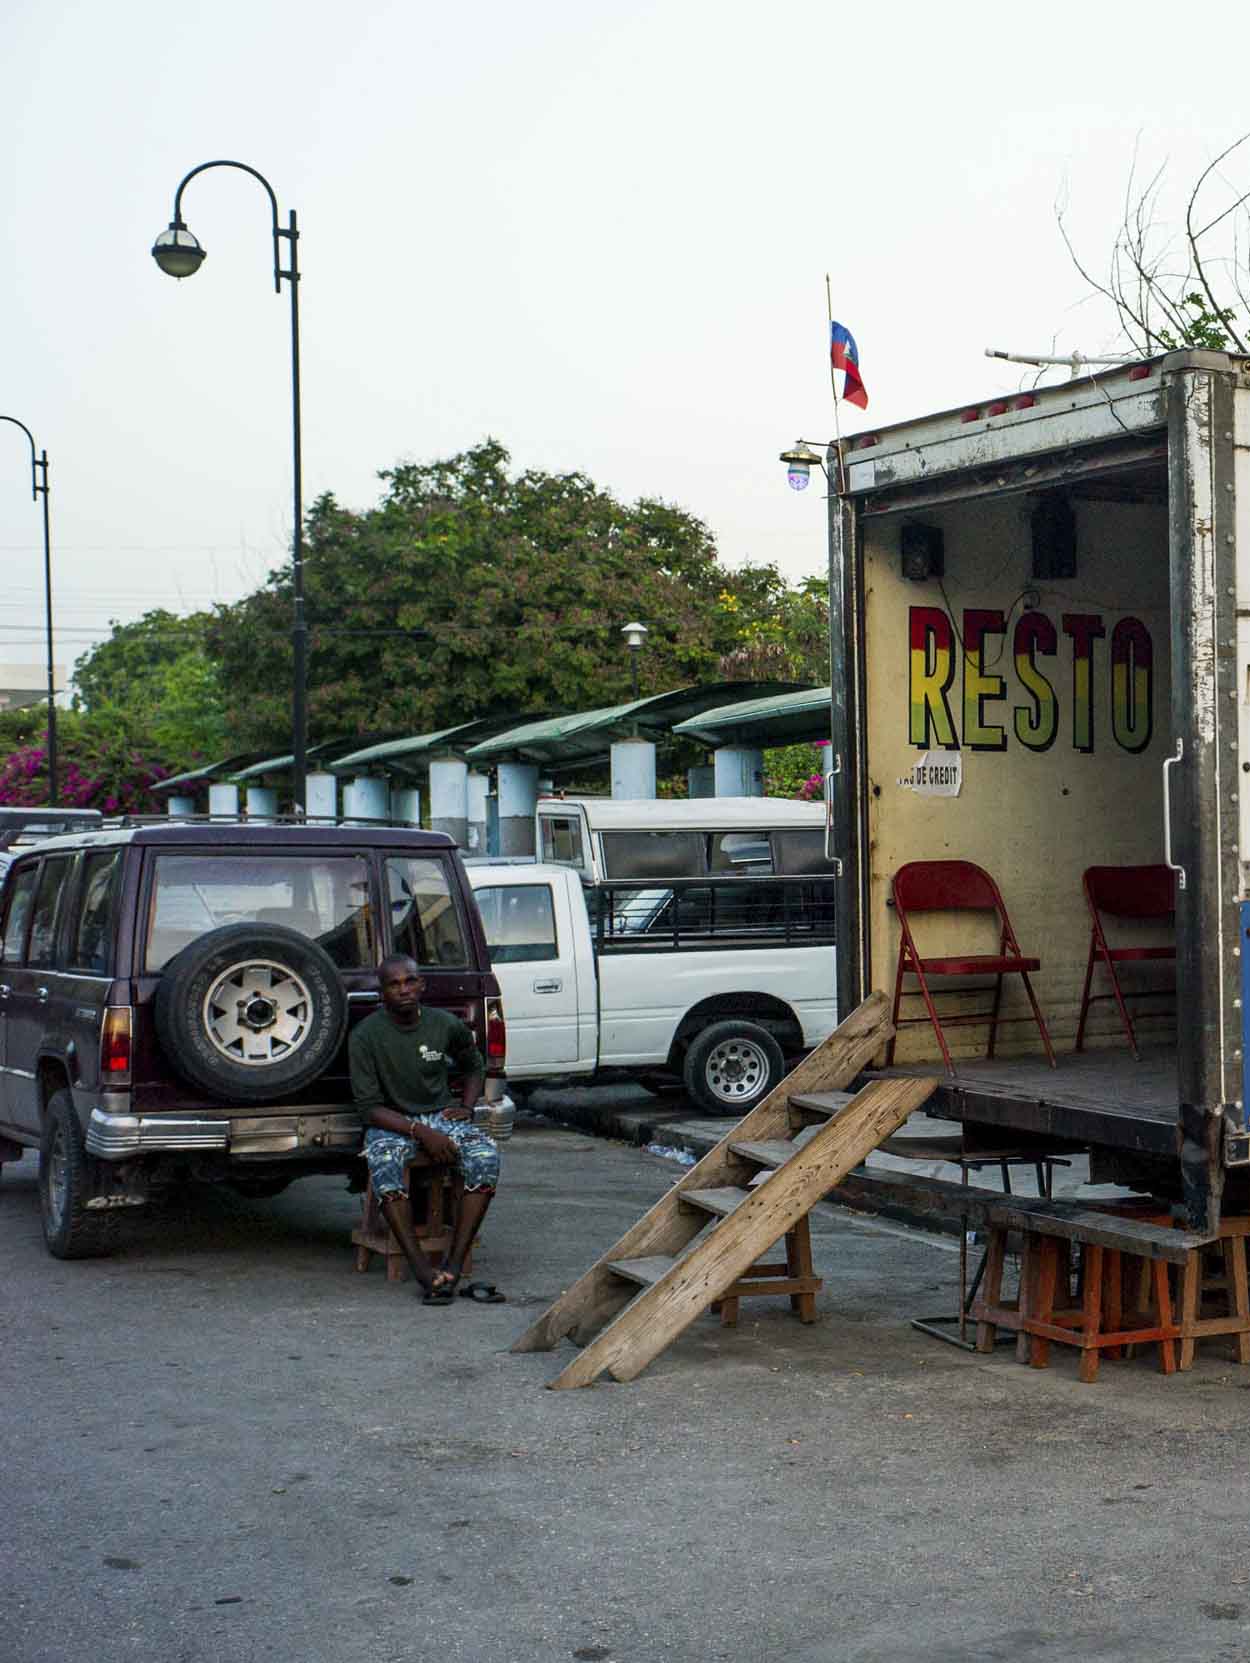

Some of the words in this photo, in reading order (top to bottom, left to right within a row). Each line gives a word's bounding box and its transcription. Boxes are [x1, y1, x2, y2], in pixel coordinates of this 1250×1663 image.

[908, 606, 1153, 753] RESTO
[916, 766, 927, 784] DE
[929, 766, 958, 784] CREDIT
